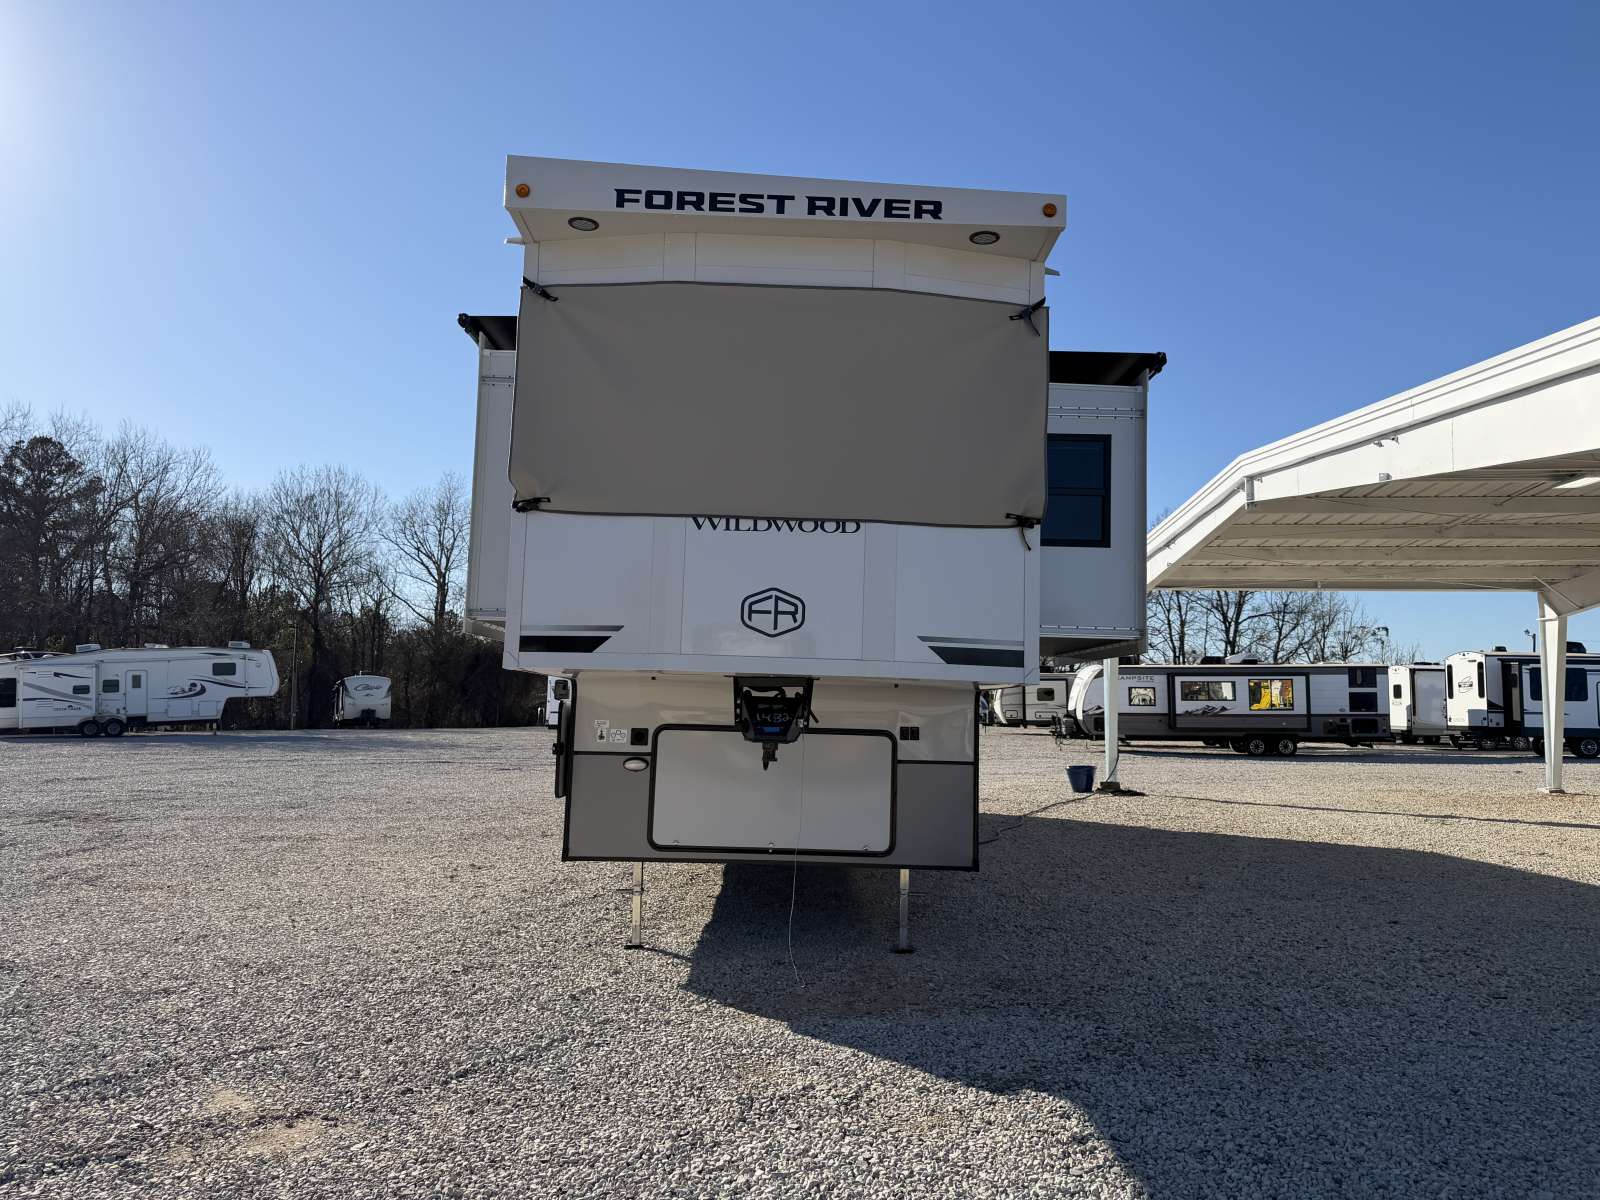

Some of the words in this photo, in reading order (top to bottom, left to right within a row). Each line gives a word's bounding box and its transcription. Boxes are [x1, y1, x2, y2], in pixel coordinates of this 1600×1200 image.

[614, 188, 795, 215] FOREST
[805, 195, 943, 220] RIVER
[691, 516, 861, 534] WILDWOOD
